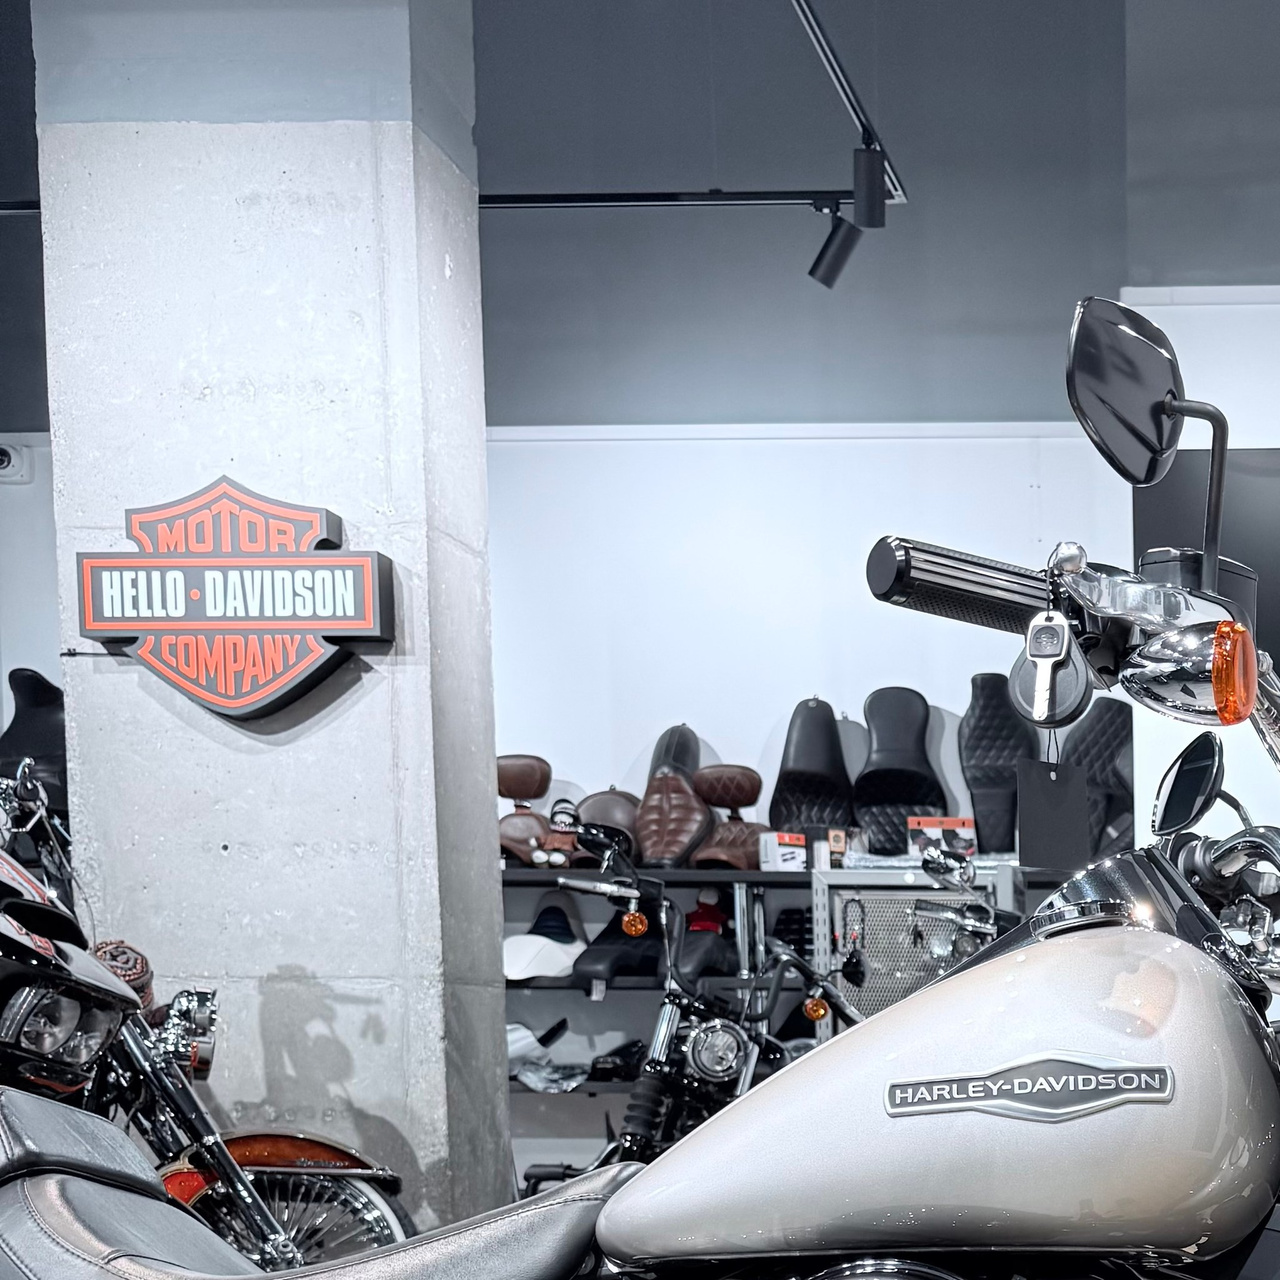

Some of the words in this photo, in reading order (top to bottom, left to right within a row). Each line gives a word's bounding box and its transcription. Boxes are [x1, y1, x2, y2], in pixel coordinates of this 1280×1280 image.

[156, 498, 296, 553] MOTOR
[101, 569, 186, 618] HELLO
[204, 569, 355, 617] DAVIDSON
[160, 634, 301, 696] COMPANY
[895, 1073, 1162, 1104] HARLEY-DAVIDSON
